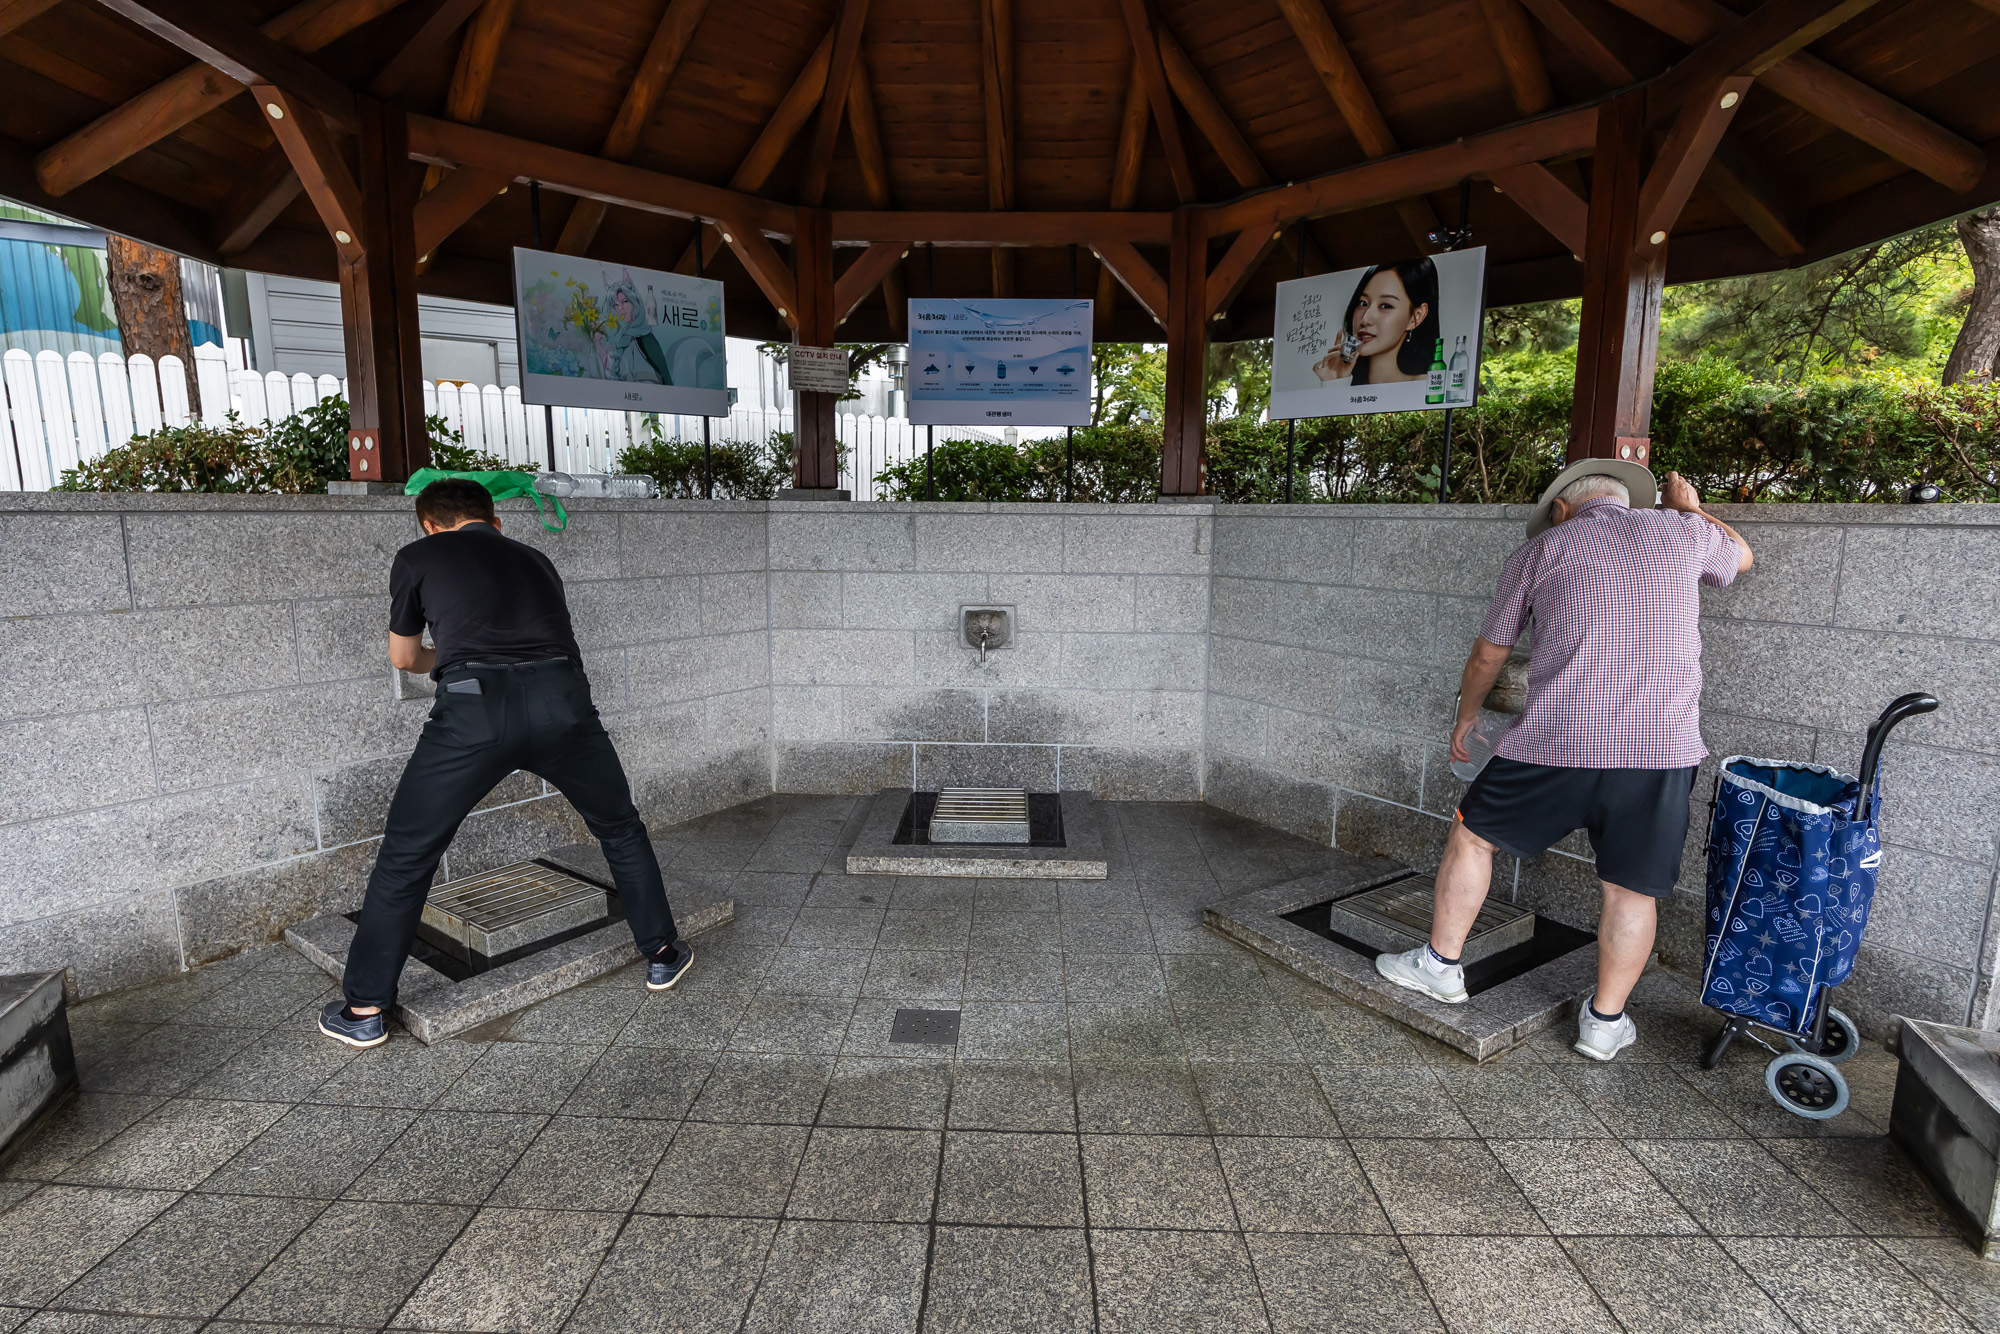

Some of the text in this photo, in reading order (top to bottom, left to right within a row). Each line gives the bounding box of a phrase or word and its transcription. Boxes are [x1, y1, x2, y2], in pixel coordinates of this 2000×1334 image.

[1301, 294, 1322, 309] 우리의
[662, 304, 699, 328] 새로
[795, 350, 815, 358] CCTV
[624, 392, 639, 401] 새로
